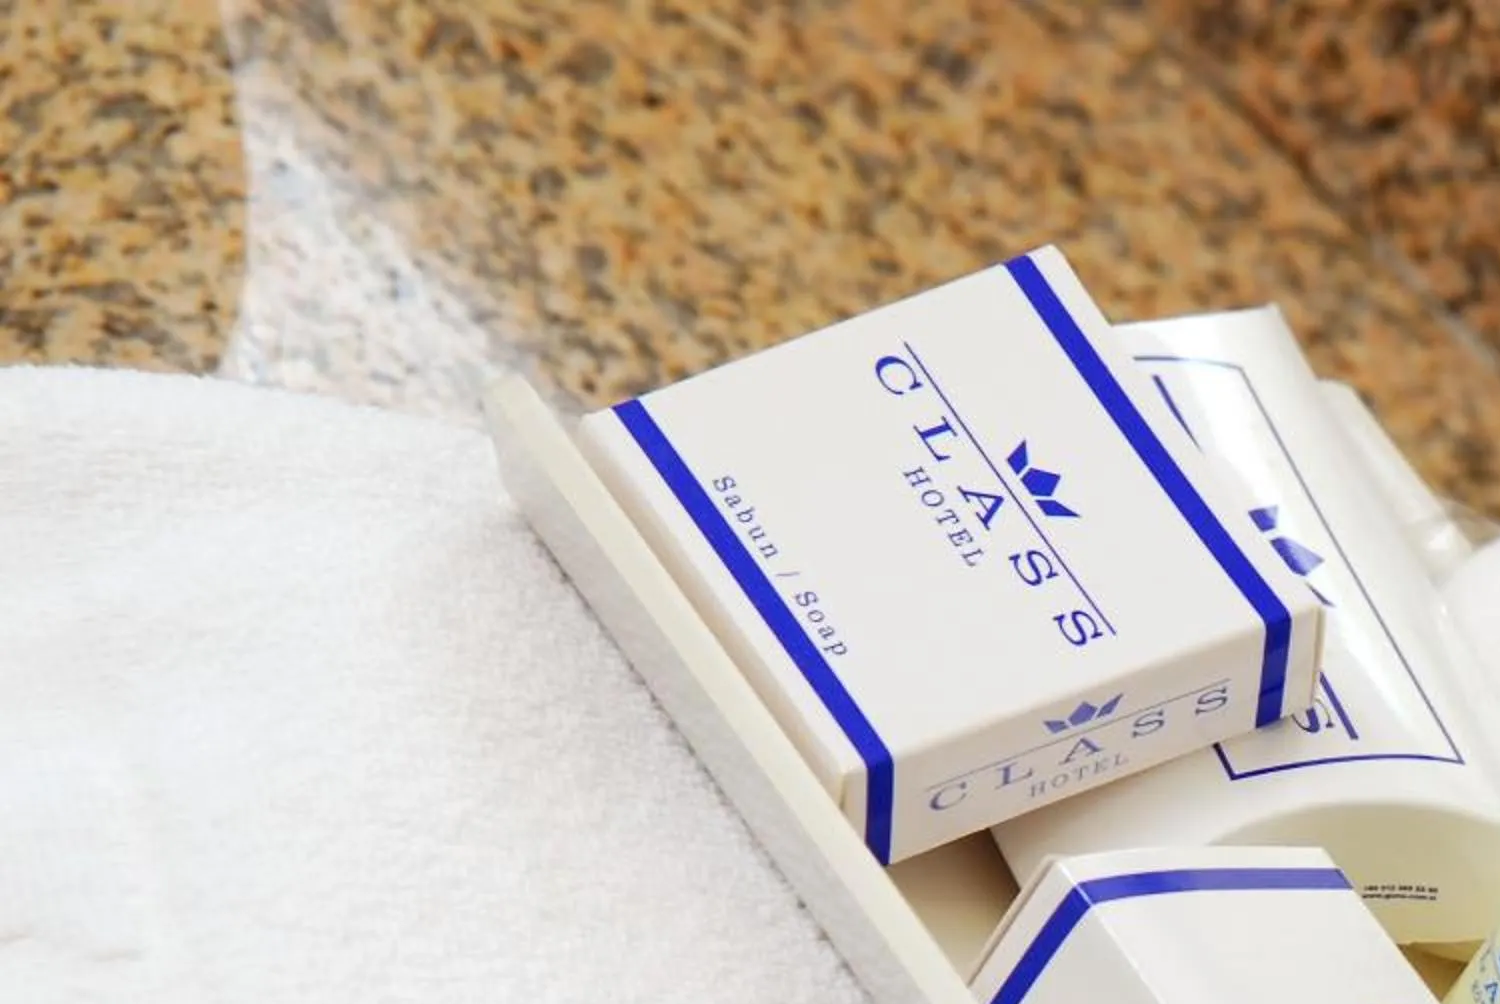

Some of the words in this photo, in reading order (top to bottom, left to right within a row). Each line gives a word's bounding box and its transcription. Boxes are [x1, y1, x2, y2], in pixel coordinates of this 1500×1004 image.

[875, 355, 1104, 647] CLASS
[902, 466, 984, 567] HOTEL
[712, 475, 779, 559] Sabun
[793, 591, 848, 657] Soap
[929, 686, 1229, 811] CLASS
[1028, 752, 1130, 798] HOTEL
